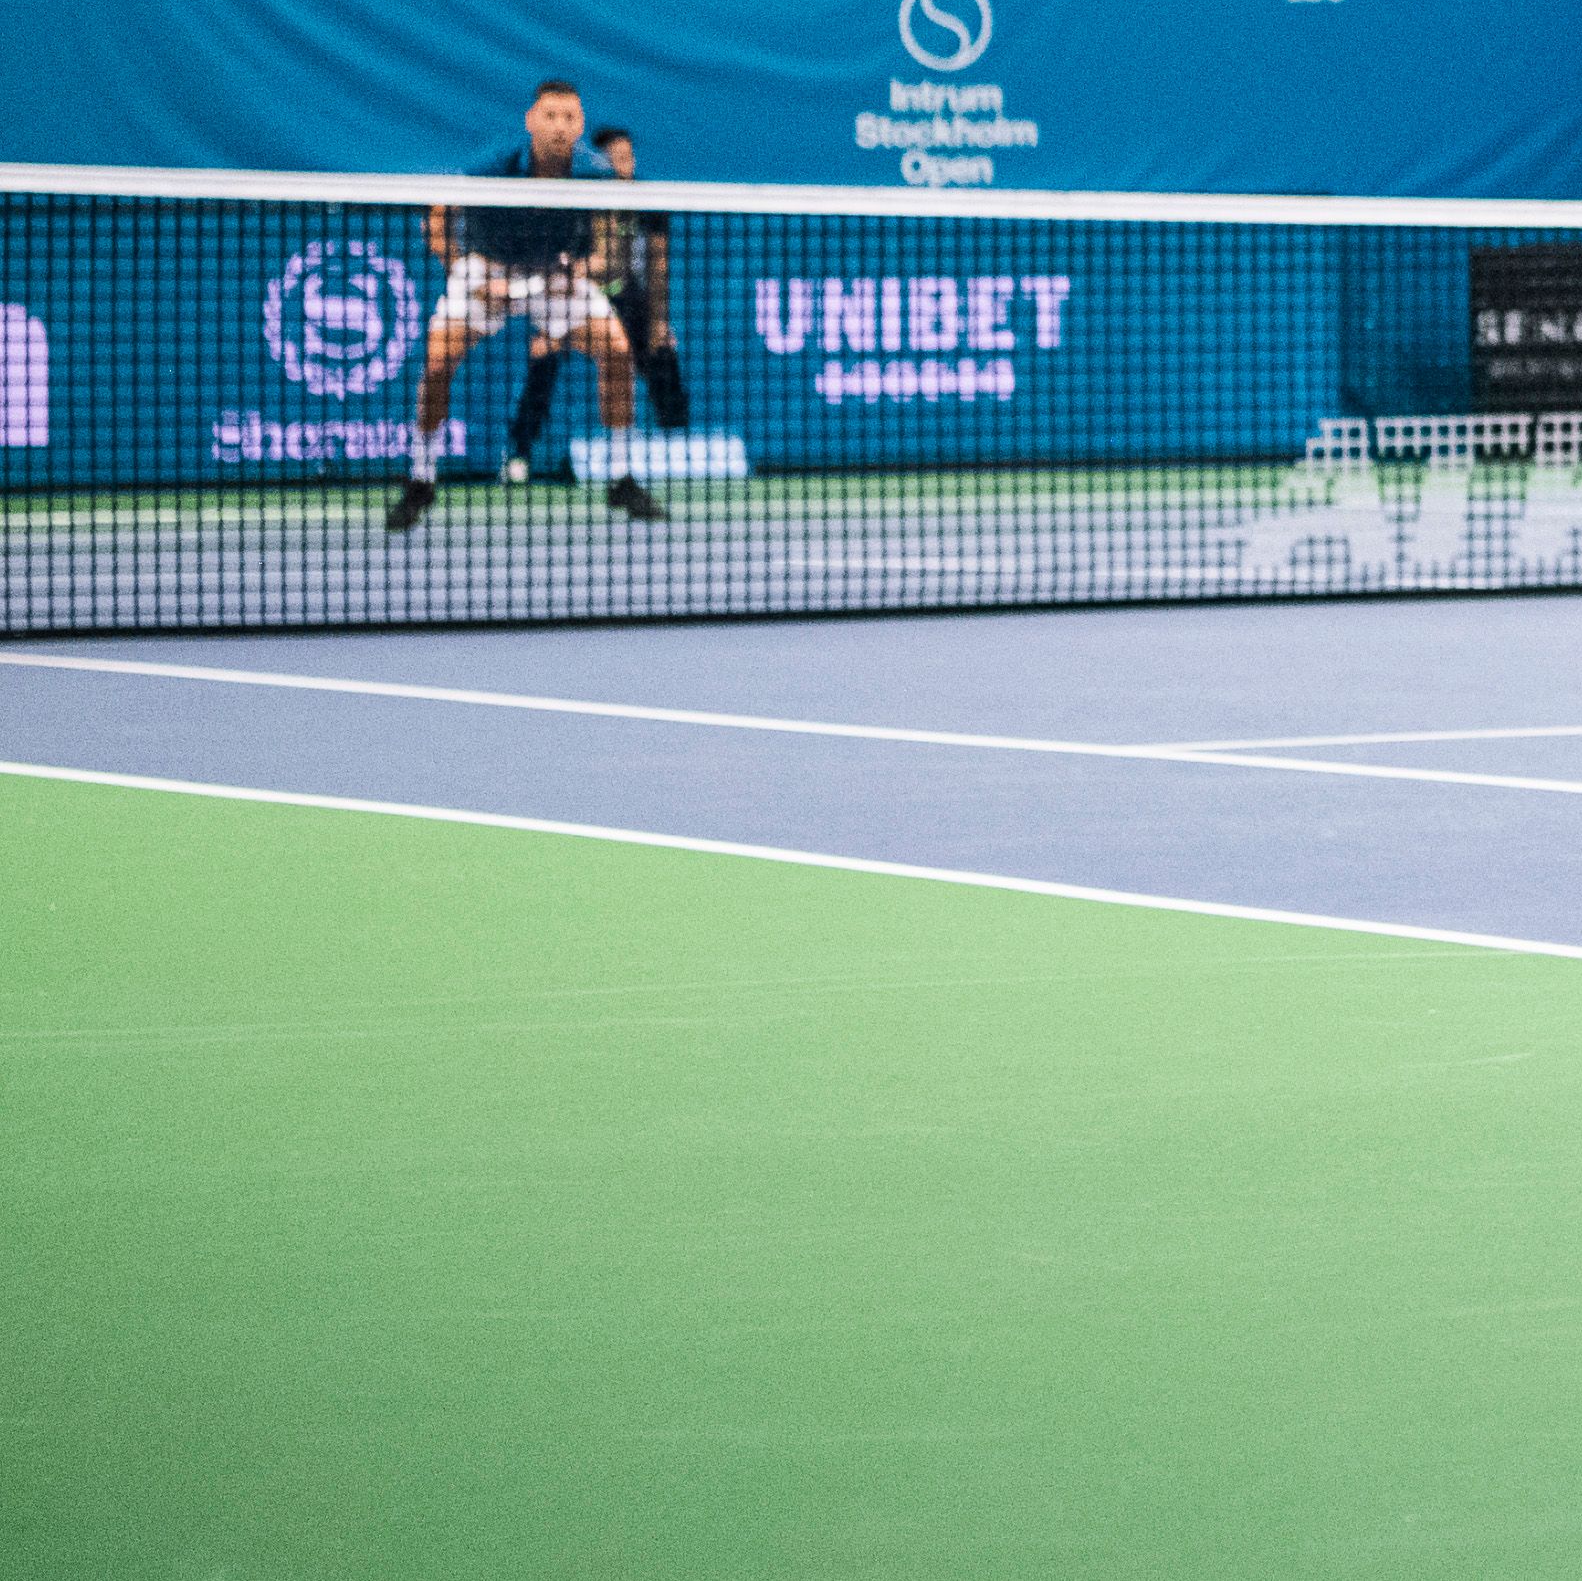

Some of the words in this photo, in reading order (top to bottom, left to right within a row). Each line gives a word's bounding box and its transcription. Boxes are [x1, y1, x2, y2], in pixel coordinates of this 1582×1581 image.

[855, 112, 1039, 148] Stockholm
[901, 149, 993, 187] Open
[755, 275, 1071, 353] UNIBET
